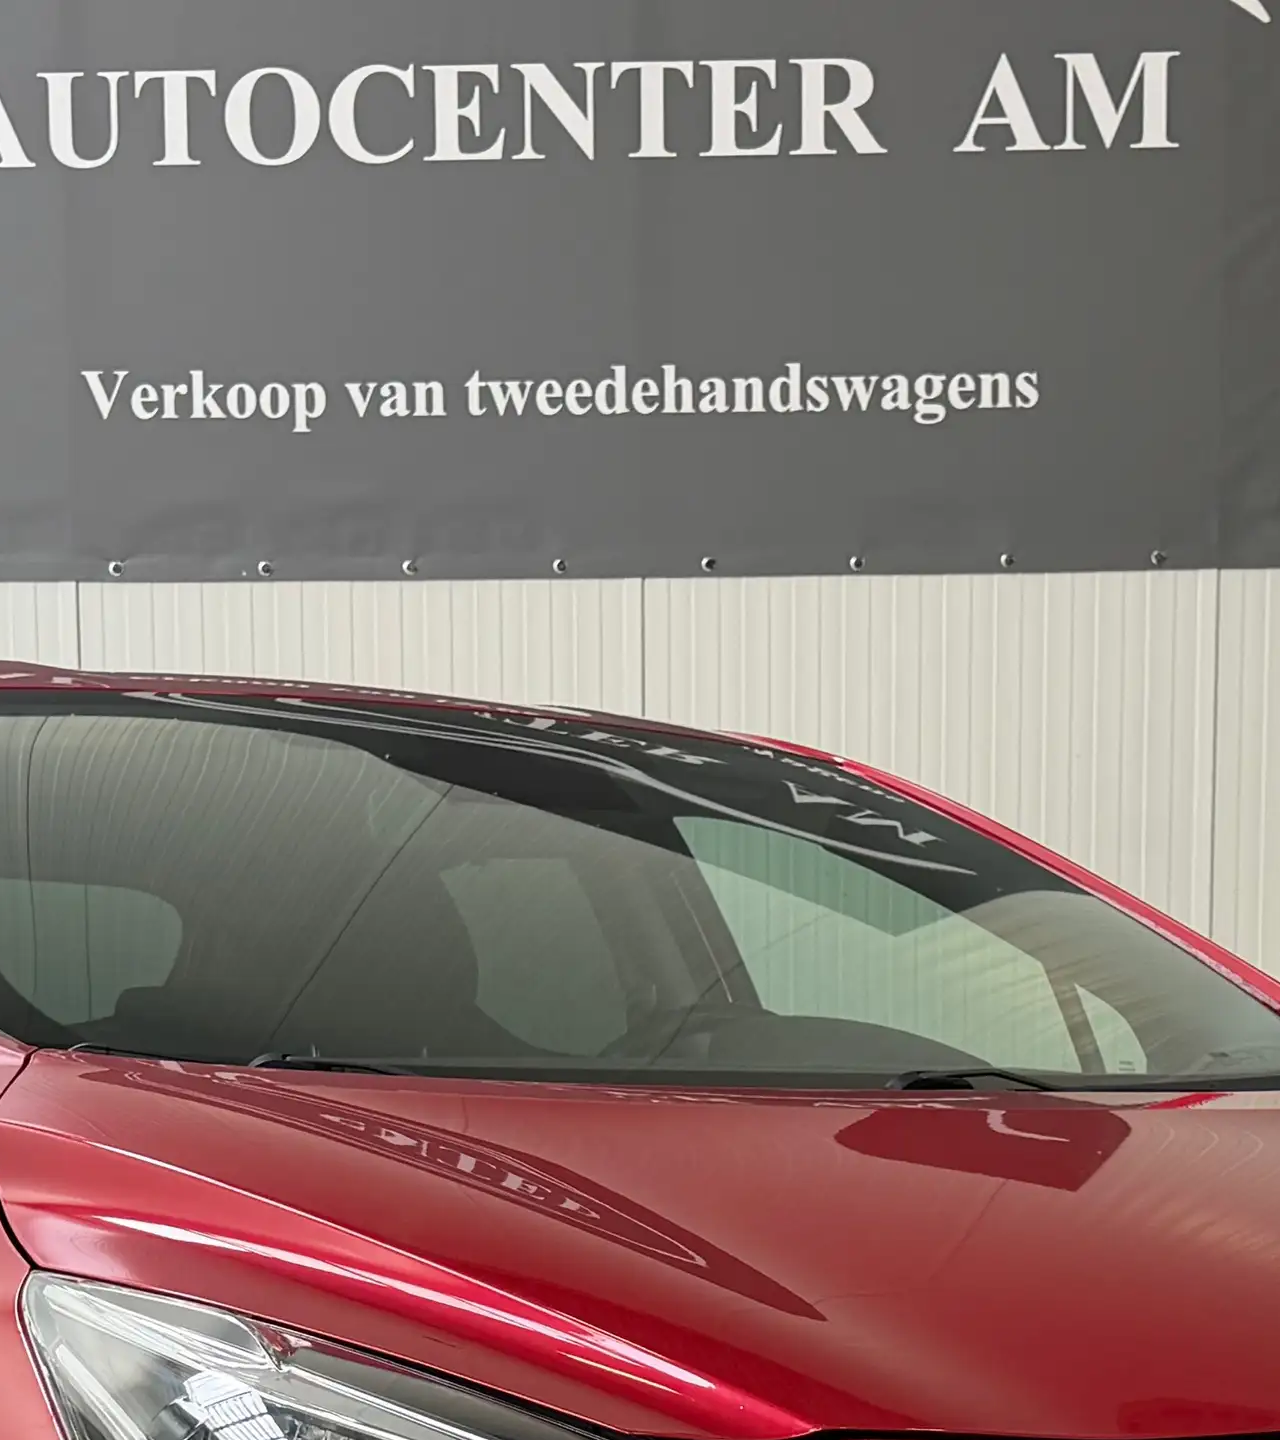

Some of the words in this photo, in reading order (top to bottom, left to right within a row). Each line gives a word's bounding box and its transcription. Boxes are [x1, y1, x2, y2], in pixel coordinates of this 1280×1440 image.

[952, 51, 1182, 154] AM
[80, 367, 327, 433] Verkoop
[344, 380, 447, 418] van
[464, 362, 1040, 426] tweedehandswagens
